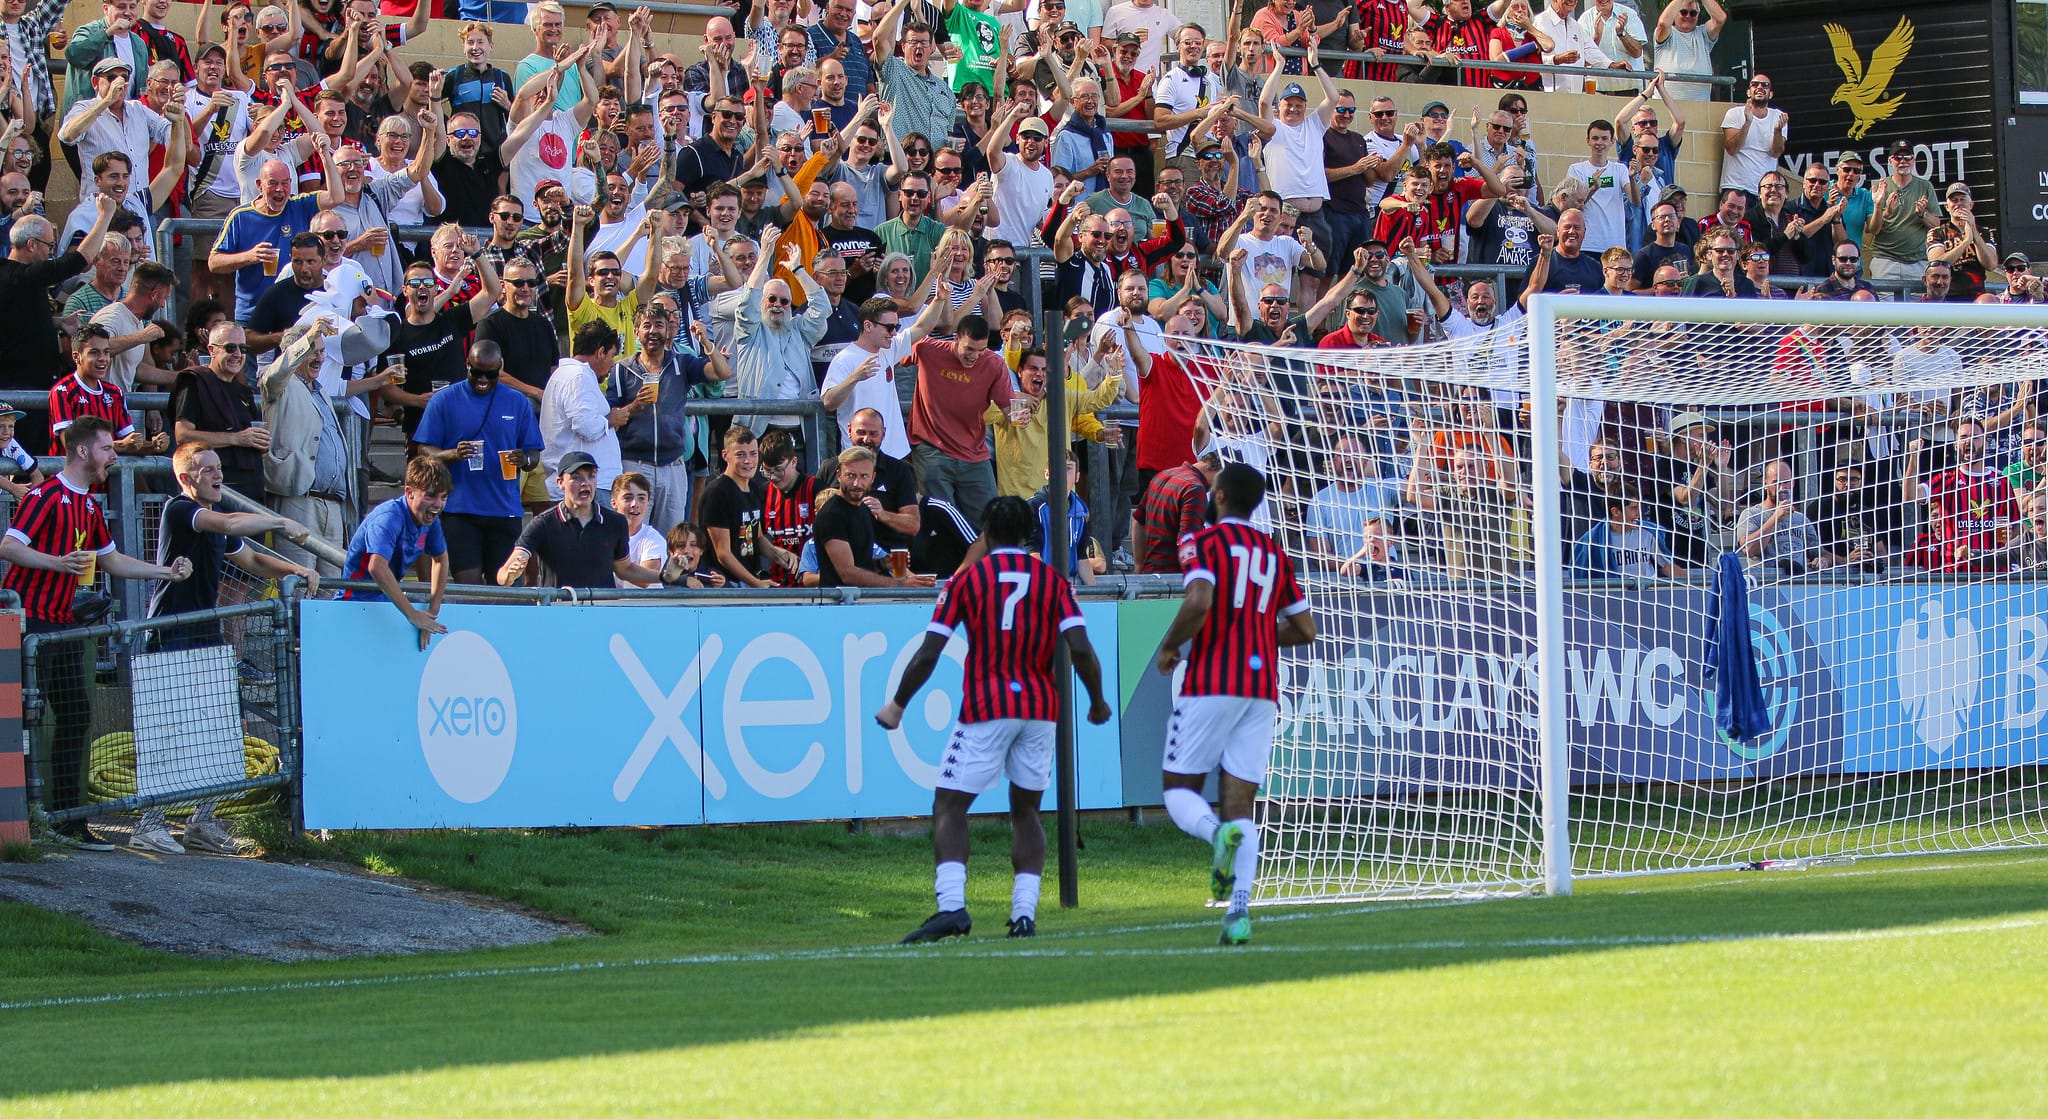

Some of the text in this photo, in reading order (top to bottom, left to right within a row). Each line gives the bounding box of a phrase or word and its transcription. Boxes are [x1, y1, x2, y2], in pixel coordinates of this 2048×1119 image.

[1496, 246, 1532, 266] AWAKE
[999, 572, 1031, 630] 7
[1230, 545, 1277, 614] 14
[428, 696, 506, 736] xero
